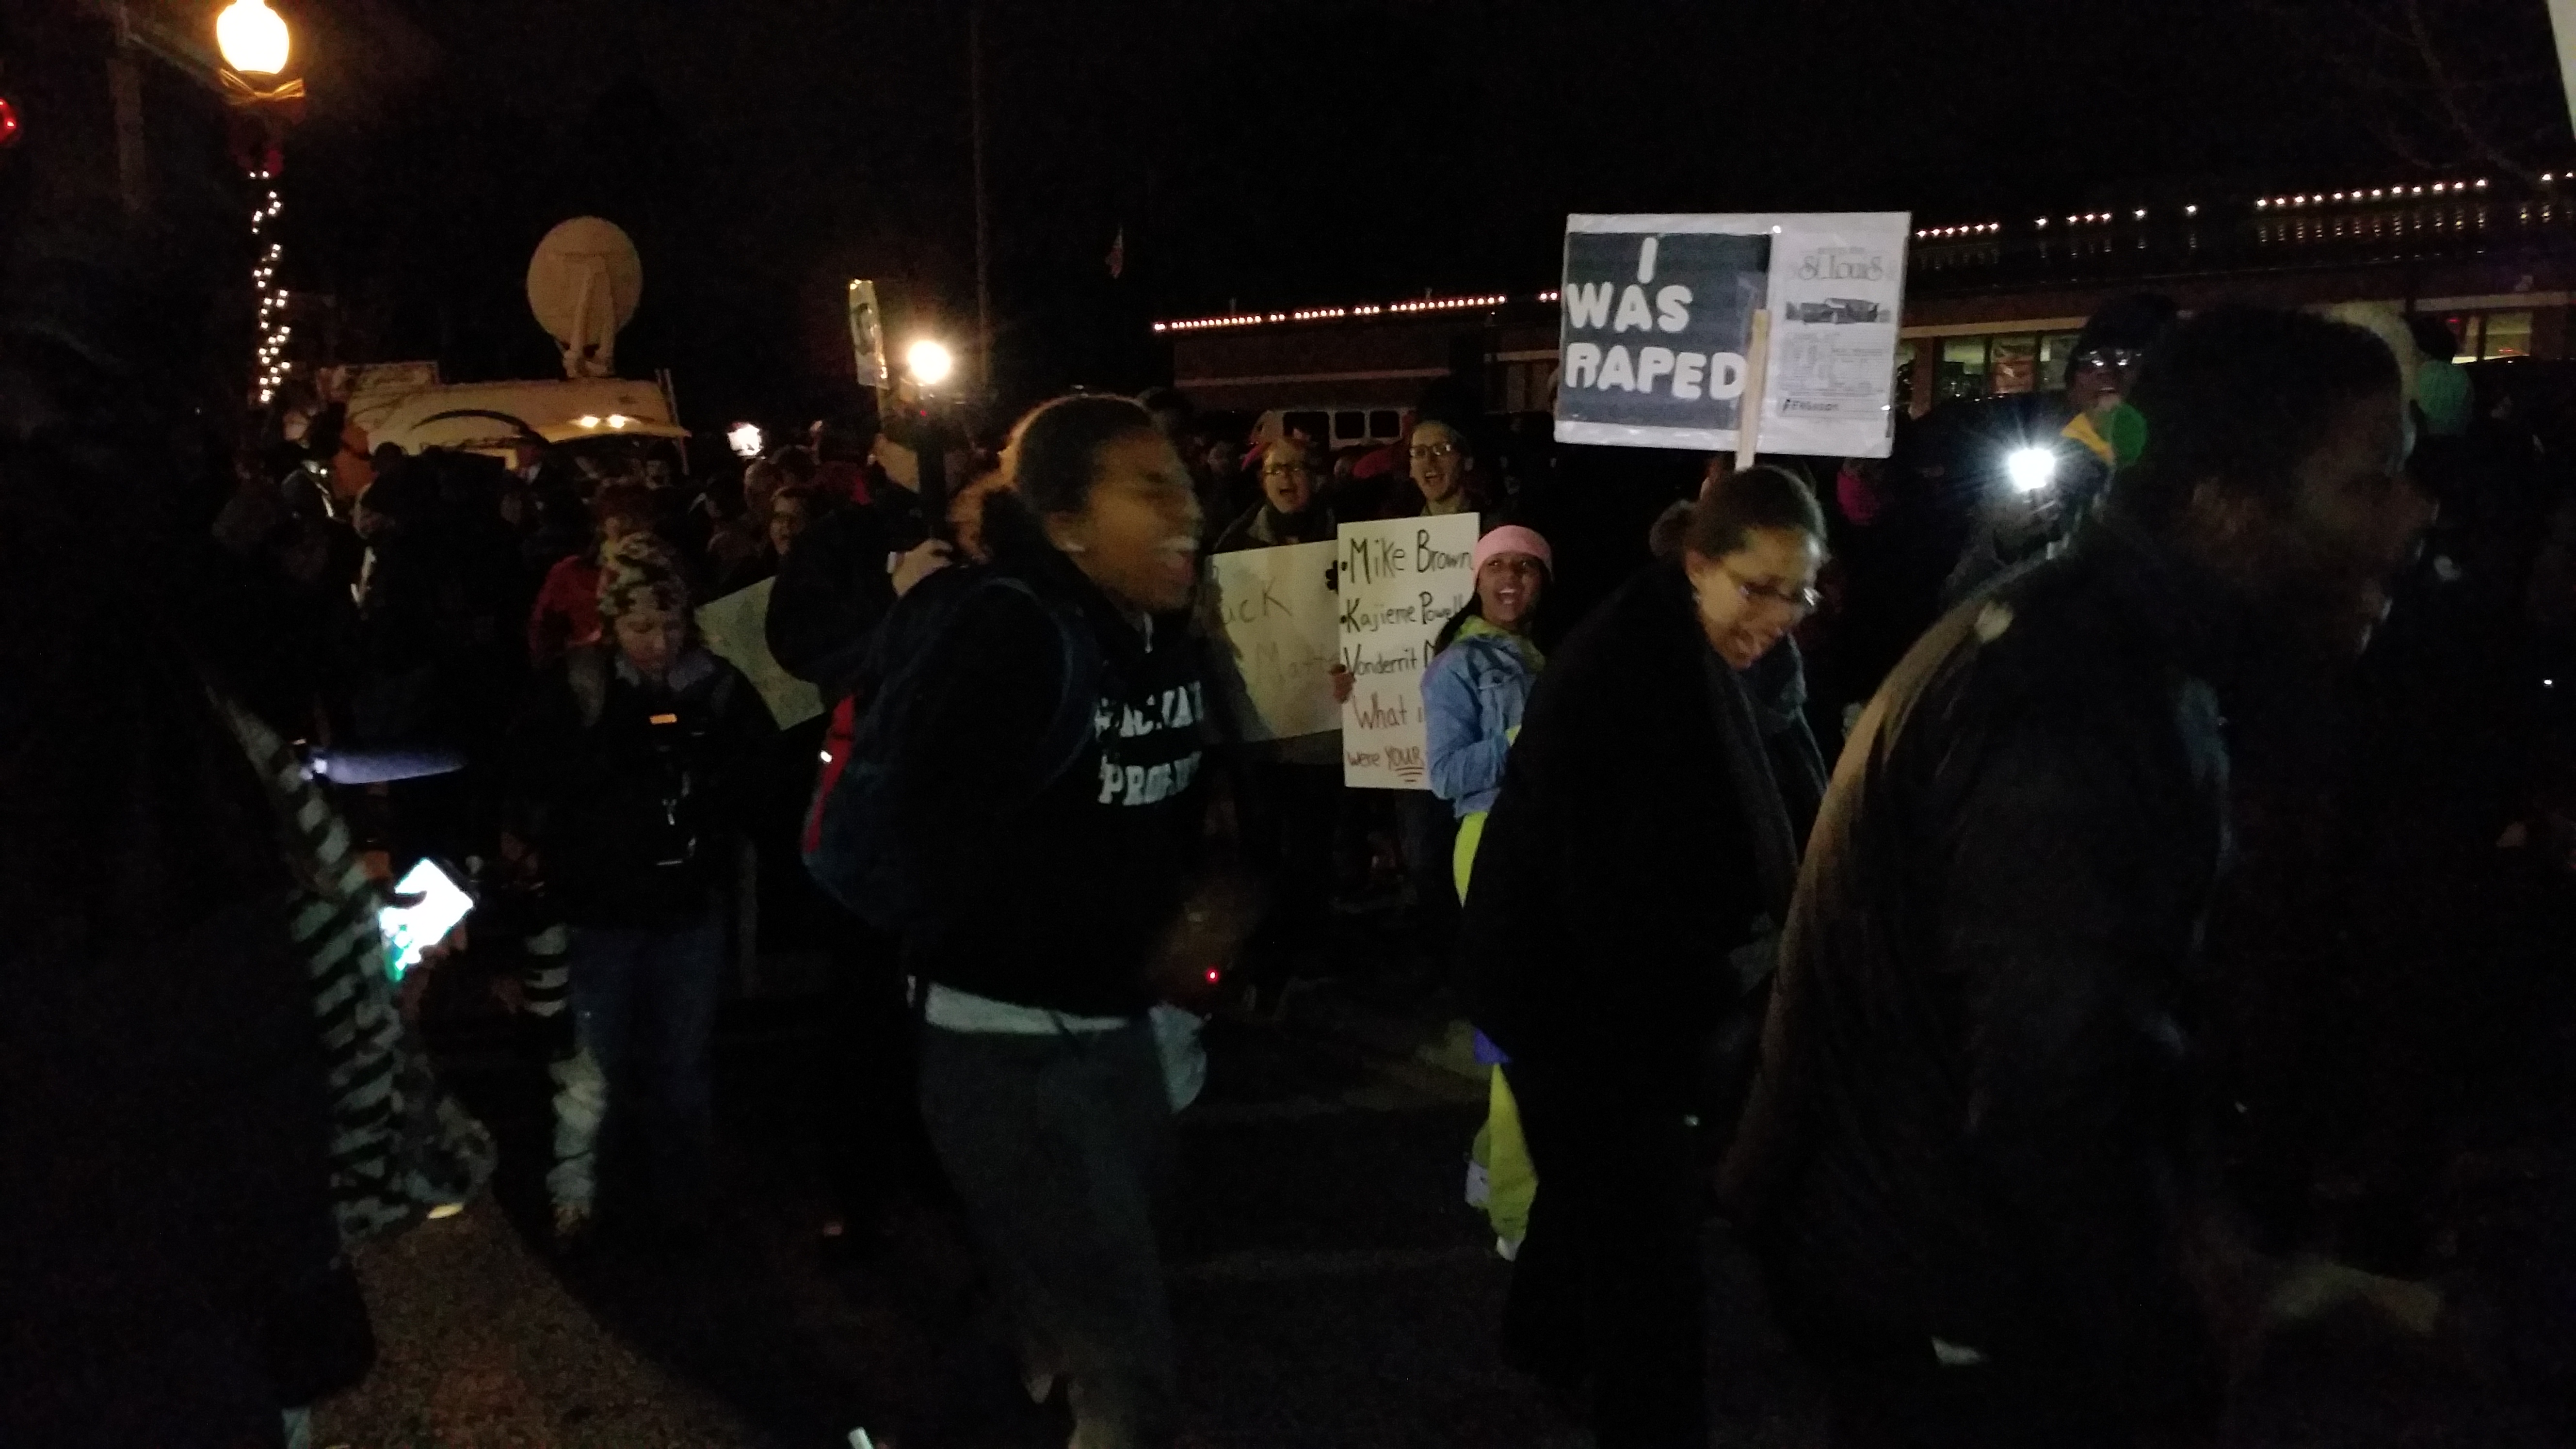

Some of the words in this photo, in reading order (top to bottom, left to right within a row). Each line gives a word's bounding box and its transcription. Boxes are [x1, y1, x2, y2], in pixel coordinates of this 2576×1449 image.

[1637, 237, 1659, 284] I
[1566, 281, 1693, 333] WAS
[1565, 342, 1747, 400] RAPED
[1417, 529, 1474, 573] Brown
[1352, 692, 1407, 730] What
